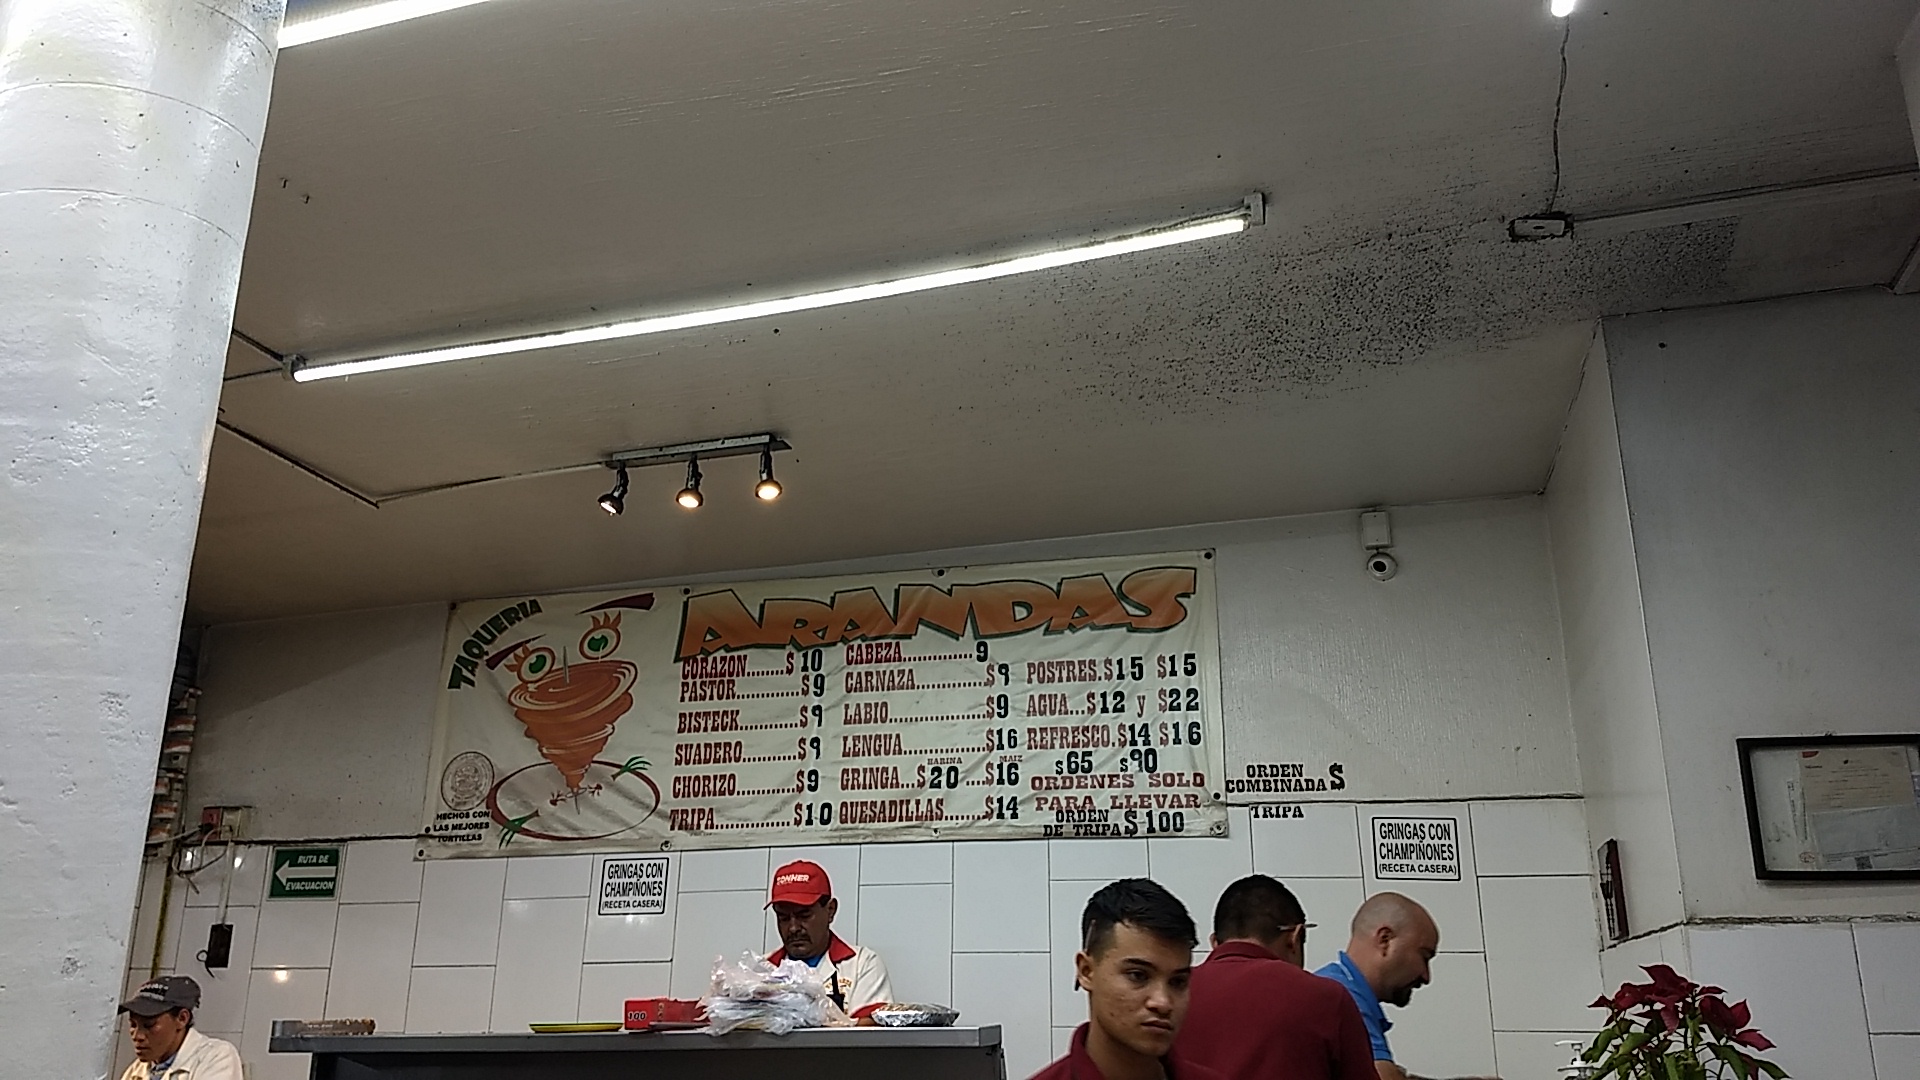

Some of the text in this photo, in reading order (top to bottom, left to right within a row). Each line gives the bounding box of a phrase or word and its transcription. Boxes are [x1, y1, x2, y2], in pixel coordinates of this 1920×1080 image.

[674, 566, 1197, 663] ARANDAS
[447, 598, 543, 690] TAQUERIA
[846, 641, 989, 666] CABEZA 9
[681, 654, 747, 680] CORAZON
[1157, 653, 1197, 680] $15
[680, 679, 736, 702] PASTOR
[845, 668, 915, 694] CARNAZA
[1137, 694, 1146, 718] y
[1158, 687, 1200, 714] $22
[677, 709, 740, 734] BISTECK
[843, 701, 889, 726] LABIO
[842, 727, 1018, 758] LENGUA $16
[1117, 722, 1151, 749] $14
[1159, 721, 1202, 748] $16
[674, 741, 743, 766] SUADERO
[927, 757, 963, 766] HARINA
[1055, 751, 1093, 775] $65
[1246, 764, 1304, 778] ORDEN
[672, 773, 737, 798] CHORIZO
[1030, 772, 1205, 791] ORDENES SOLO
[1226, 778, 1327, 793] COMBINADA
[839, 795, 1019, 824] QUESADILLAS $14
[1035, 793, 1202, 811] PARA LLEVAR
[1250, 805, 1304, 818] TRIPA
[436, 810, 490, 820] HECHOS CON
[669, 808, 714, 831] TRIPA
[1055, 809, 1110, 823] ORDEN
[433, 822, 490, 832] LAS MEJORES
[1043, 824, 1064, 837] DE
[1073, 823, 1122, 836] TRIPA
[1380, 822, 1451, 840] GRINGAS CON
[297, 854, 330, 864] RUTA DE
[1379, 840, 1454, 861] CHAMPIÑONES
[608, 863, 663, 879] GRINGAS CON
[1379, 863, 1456, 875] (RECETA CASERA)
[285, 881, 334, 891] EVACUACION
[605, 879, 663, 897] CHAMPIÑONES
[602, 900, 662, 910] (RECETA CASERA)
[628, 1011, 646, 1020] 100
